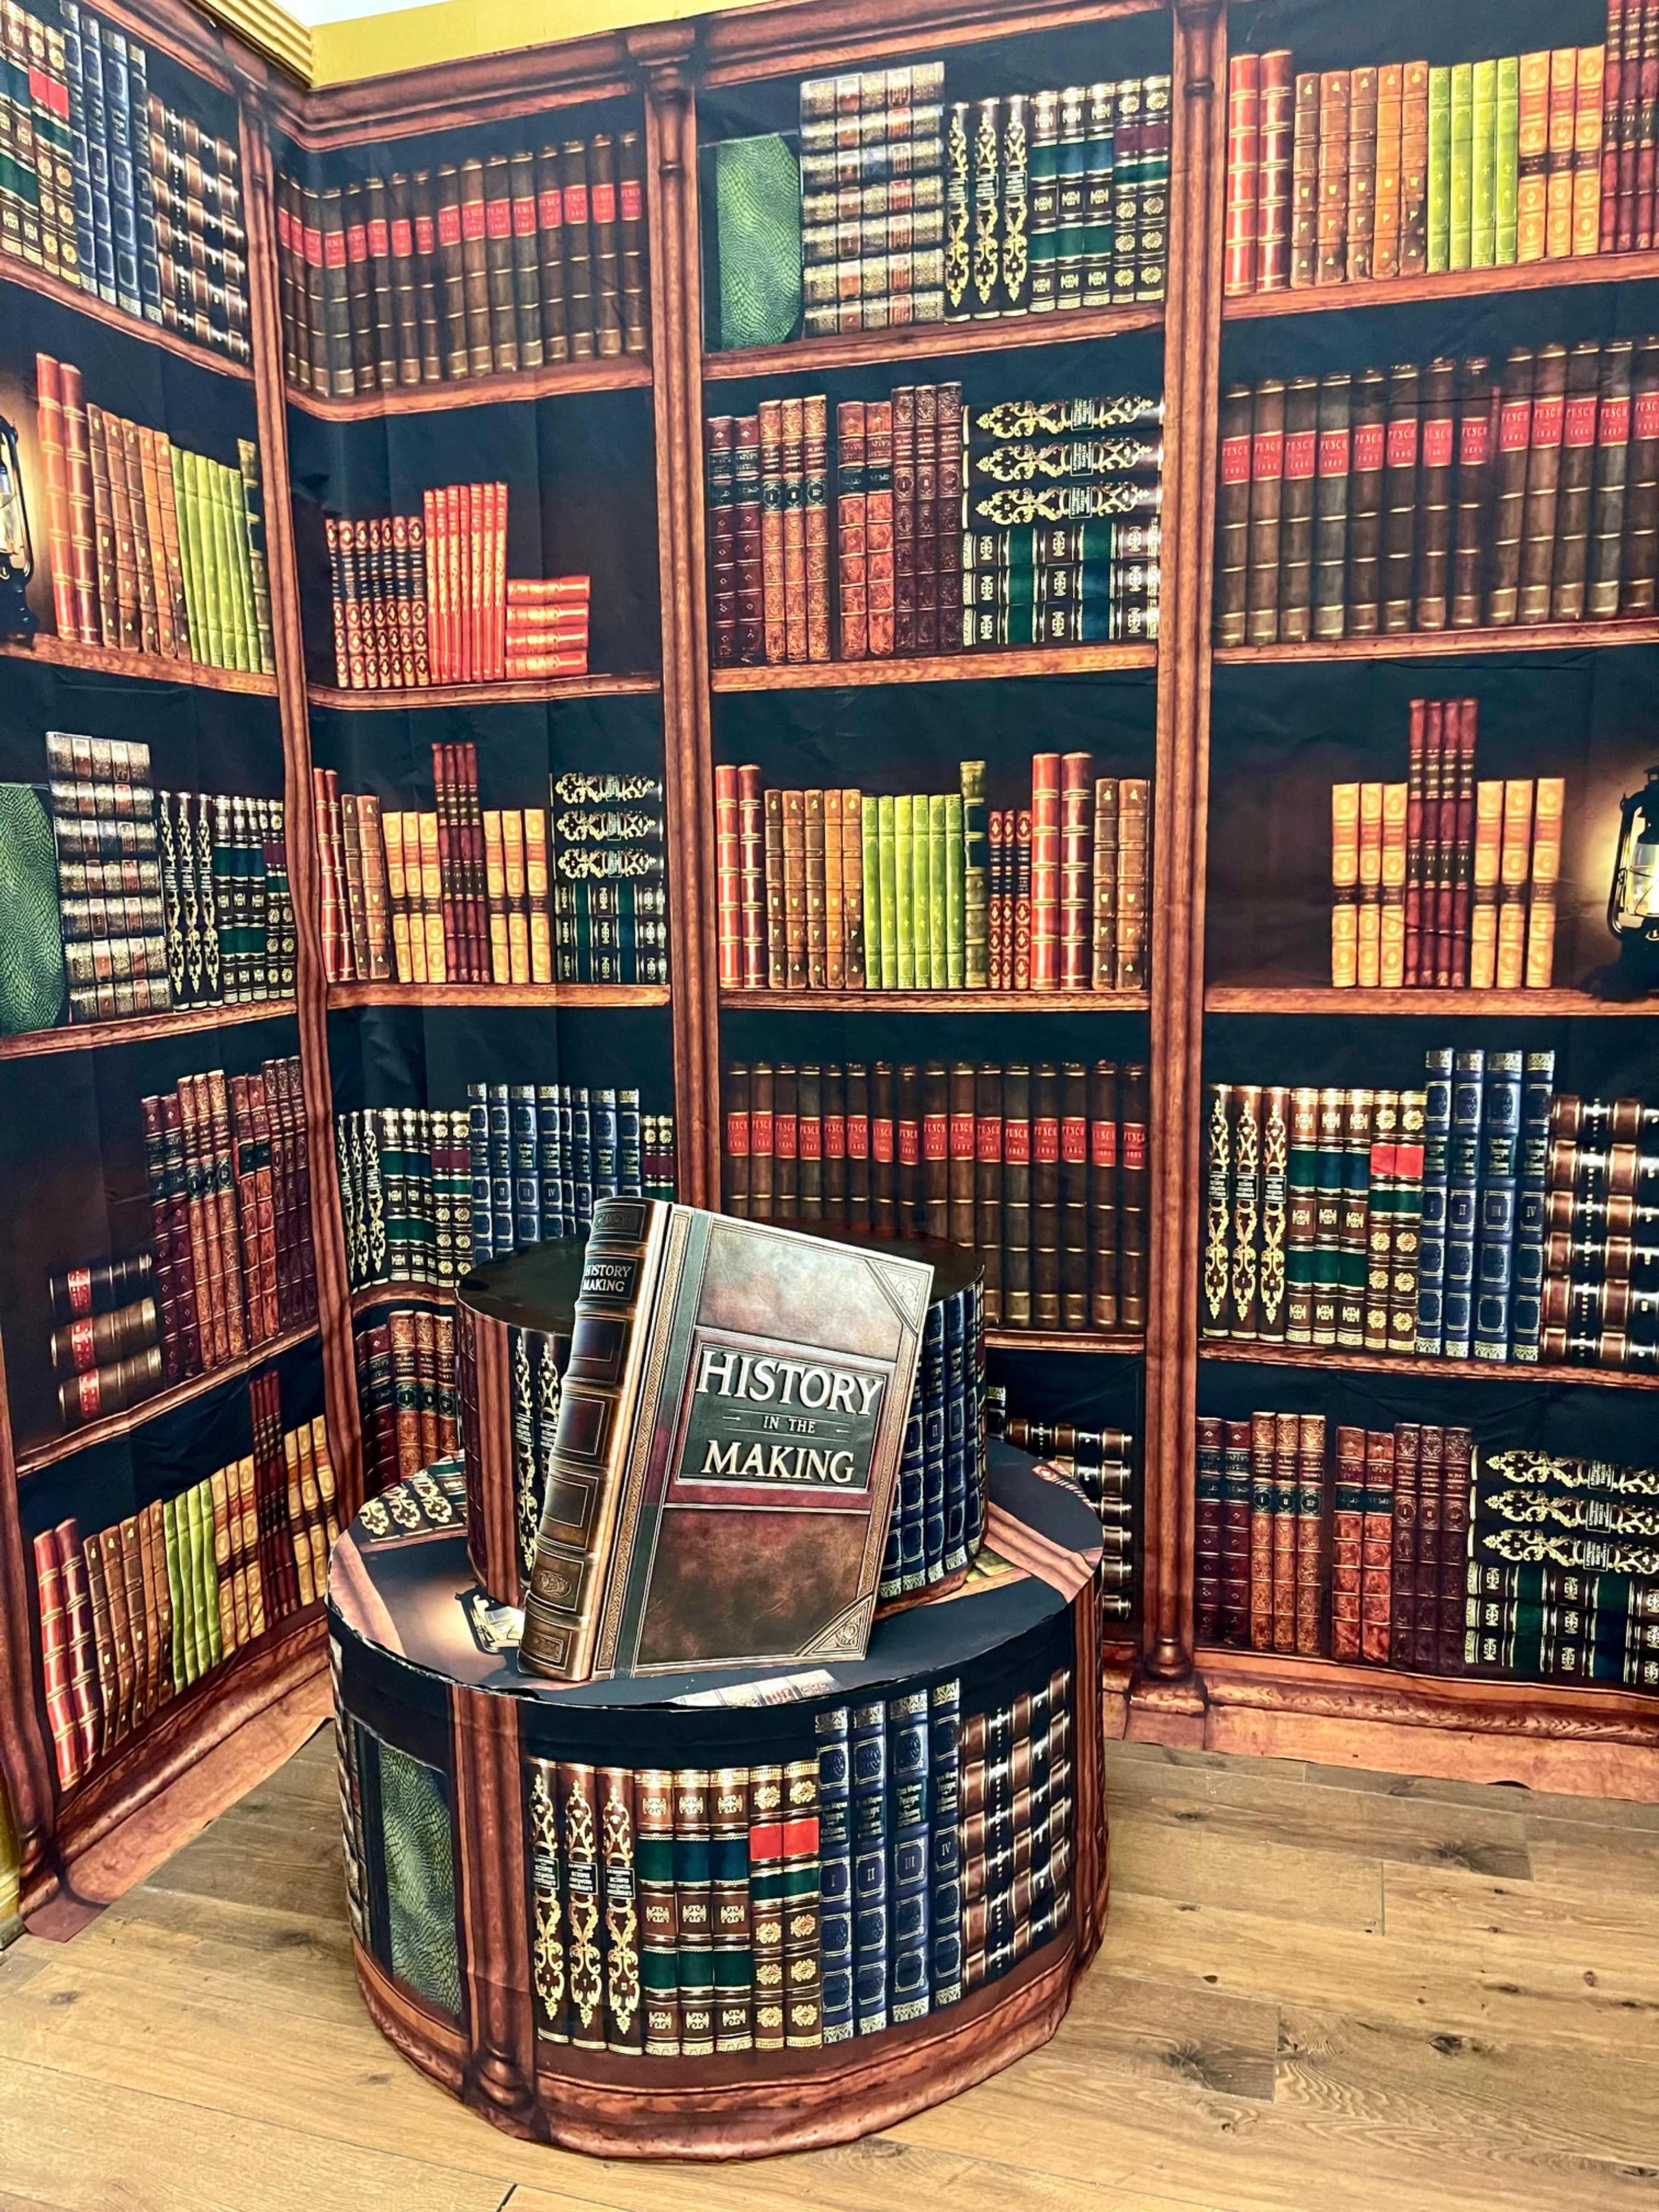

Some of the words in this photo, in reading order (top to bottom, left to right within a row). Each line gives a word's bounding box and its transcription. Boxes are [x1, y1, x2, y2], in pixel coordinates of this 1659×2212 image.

[1502, 410, 1529, 423] PUNCH
[1534, 407, 1562, 419] PUNCH
[1567, 407, 1595, 418] PUNCH
[1601, 406, 1627, 417] PUNCH
[1389, 426, 1416, 440] PUNCH
[1462, 426, 1487, 437] PUNCH
[1321, 436, 1347, 451] PUNCH
[1355, 431, 1382, 445] PUNCH
[1223, 443, 1248, 457] PUNCH
[1255, 439, 1281, 453] PUNCH
[1287, 439, 1313, 452] PUNCH
[728, 1119, 748, 1130] PUNCH
[752, 1119, 772, 1129] PUNCH
[775, 1121, 795, 1132] PUNCH
[800, 1124, 819, 1135] PUNCH
[824, 1122, 844, 1134] PUNCH
[847, 1122, 867, 1133] PUNCH
[924, 1122, 945, 1133] PUNCH
[950, 1122, 973, 1133] PUNCH
[978, 1124, 1000, 1136] PUNCH
[1062, 1124, 1084, 1136] PUNCH
[899, 1128, 918, 1139] PUNCH
[1005, 1127, 1029, 1138] PUNCH
[1034, 1125, 1058, 1137] PUNCH
[1459, 1204, 1467, 1215] II
[1491, 1205, 1501, 1217] III
[1526, 1206, 1537, 1217] IV
[584, 1264, 632, 1277] HISTORY
[582, 1278, 625, 1292] MAKING
[695, 1350, 884, 1416] HISTORY
[763, 1416, 781, 1429] IN
[788, 1418, 817, 1433] THE
[700, 1440, 855, 1484] MAKING
[942, 1842, 951, 1856] IV
[904, 1856, 915, 1870] III
[867, 1867, 875, 1881] II
[831, 1875, 836, 1887] I
